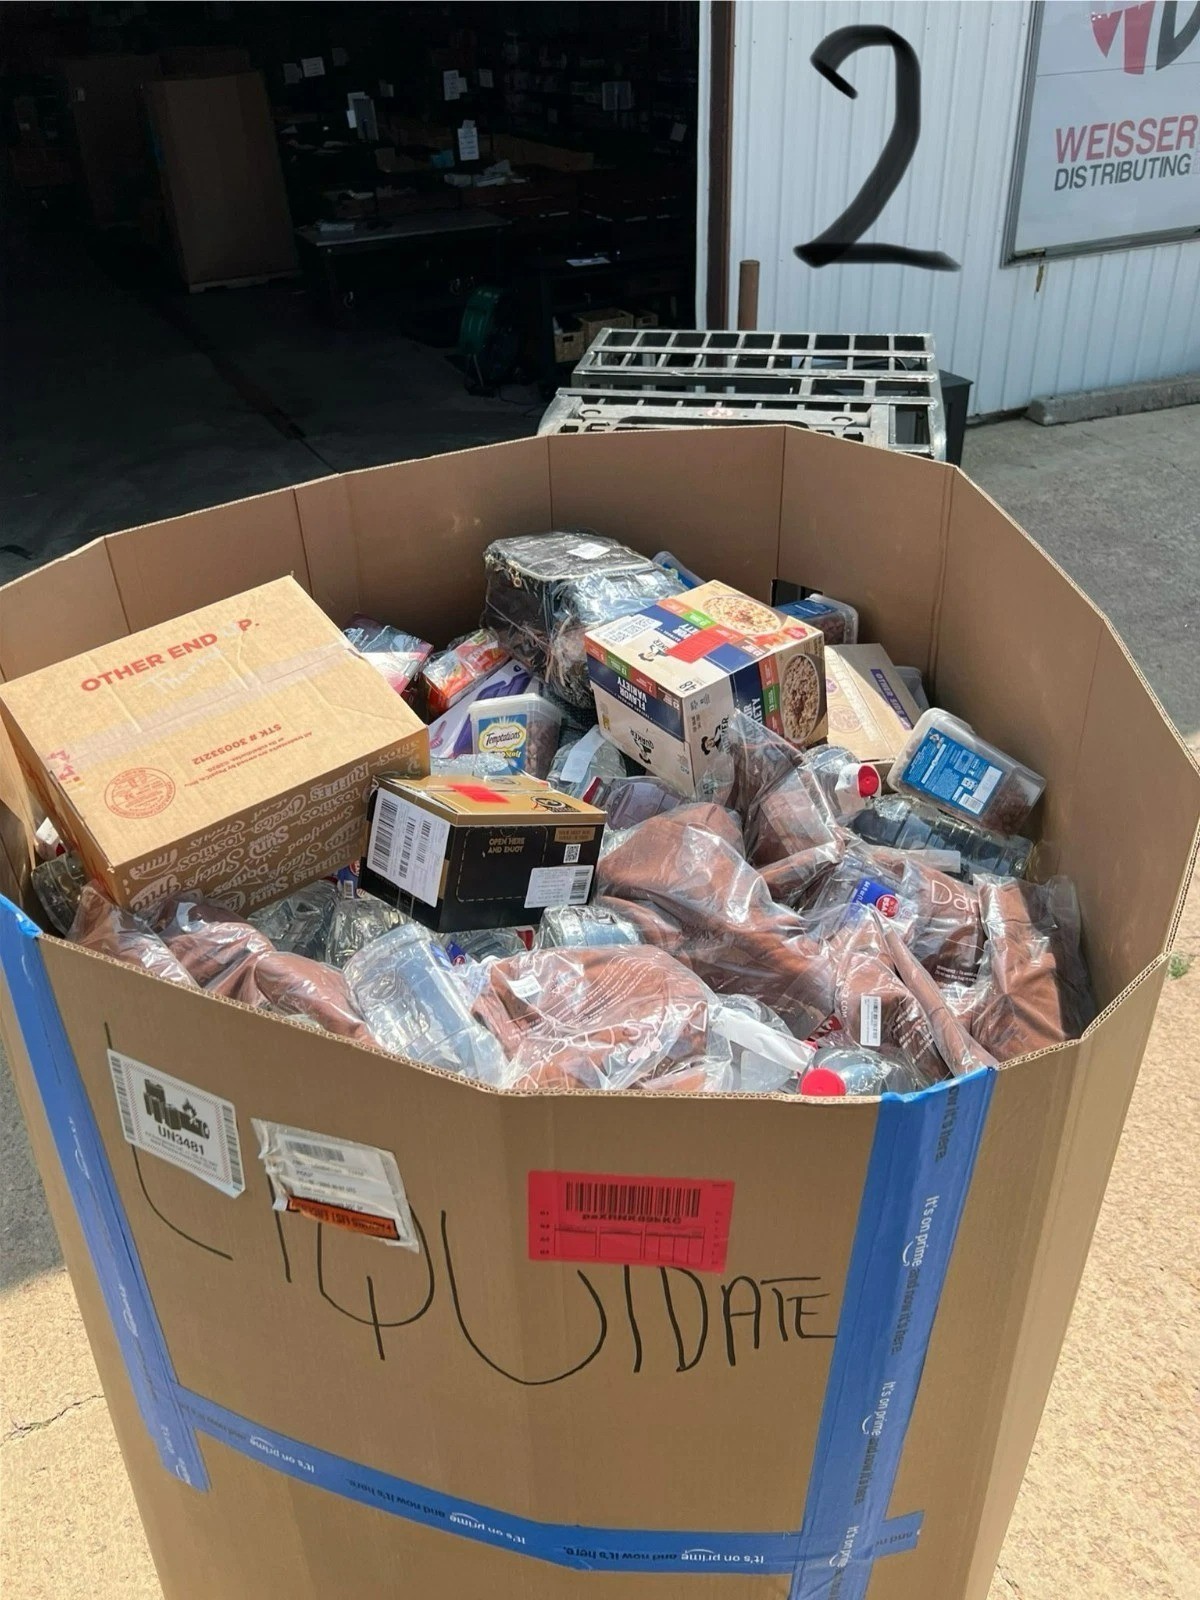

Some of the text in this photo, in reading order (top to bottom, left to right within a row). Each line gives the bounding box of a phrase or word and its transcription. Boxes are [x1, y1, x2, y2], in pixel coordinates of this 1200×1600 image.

[1055, 115, 1199, 164] WEISSER
[1054, 153, 1191, 191] DISTRIBUTING
[80, 653, 164, 692] OTHER
[168, 633, 219, 659] END
[259, 723, 282, 738] STK
[310, 762, 369, 801] RUFFLES
[254, 795, 306, 834] Cheetos
[157, 1124, 206, 1156] UN3481
[911, 1195, 939, 1267] It's on prime
[871, 1381, 896, 1436] It's on prime
[250, 1438, 315, 1473] It's on prime
[396, 1497, 421, 1511] now
[423, 1504, 446, 1518] and
[450, 1514, 526, 1545] It's on prime
[651, 1553, 677, 1562] and
[681, 1553, 764, 1565] It's on prime
